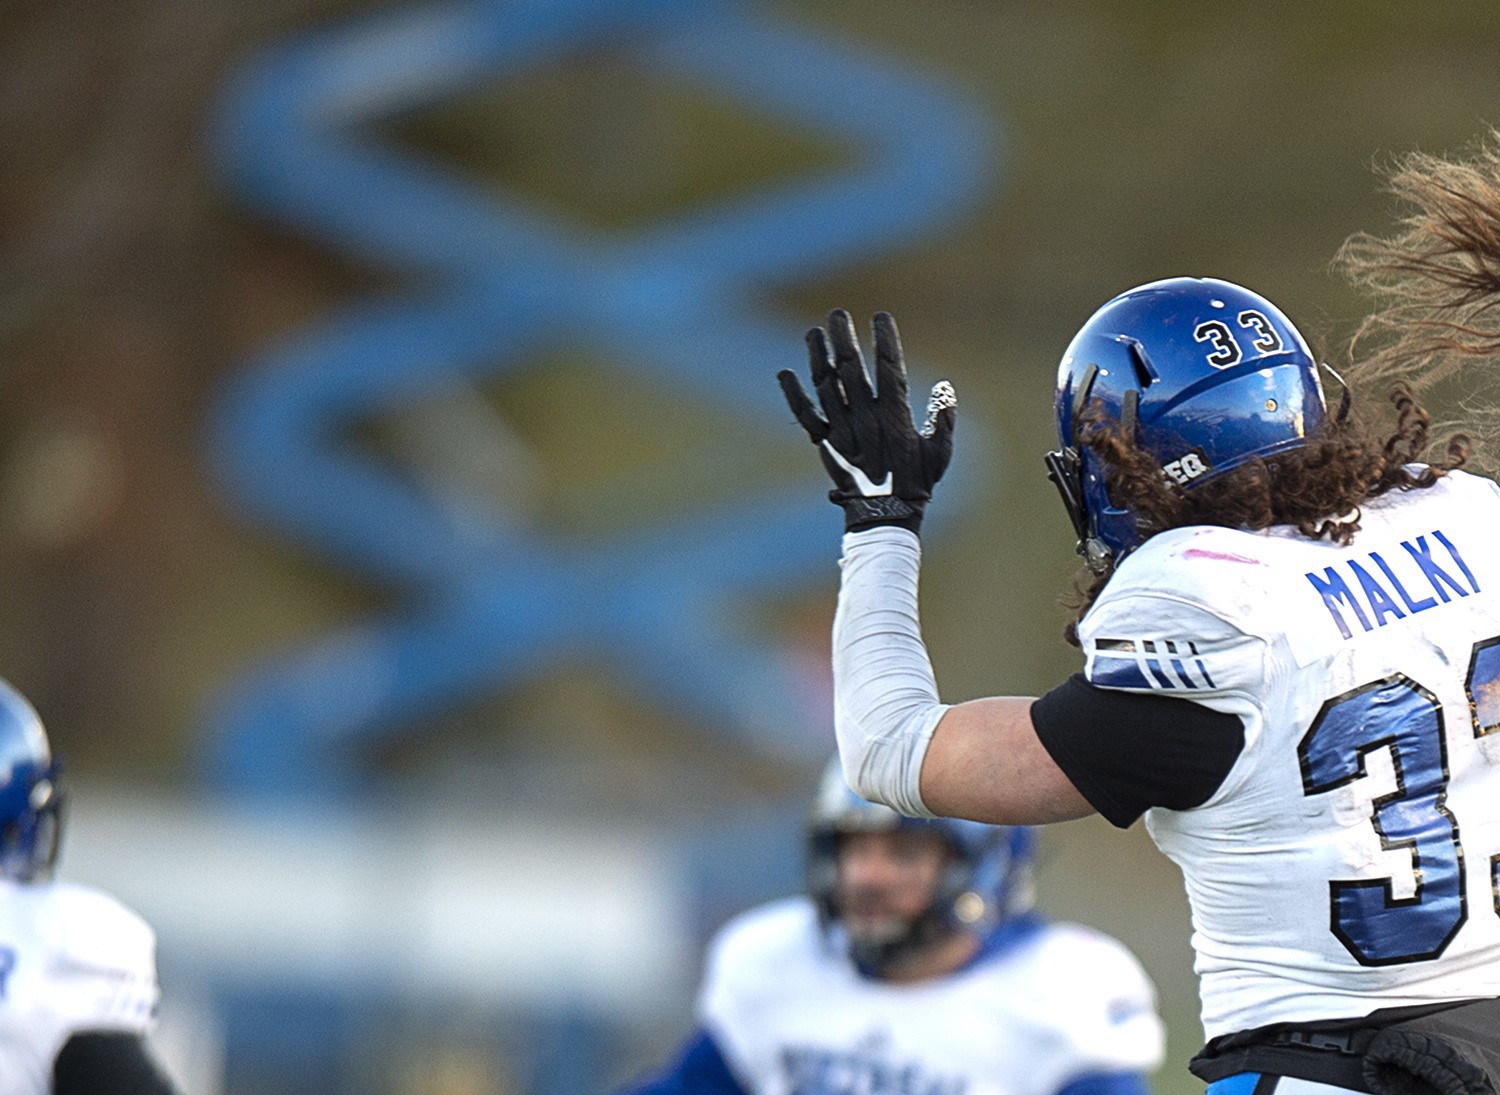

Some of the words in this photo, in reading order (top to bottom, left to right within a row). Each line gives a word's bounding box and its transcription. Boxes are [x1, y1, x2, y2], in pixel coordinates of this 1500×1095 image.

[1193, 309, 1284, 370] 33
[1160, 453, 1209, 489] EQ
[1305, 530, 1482, 640] MALKI
